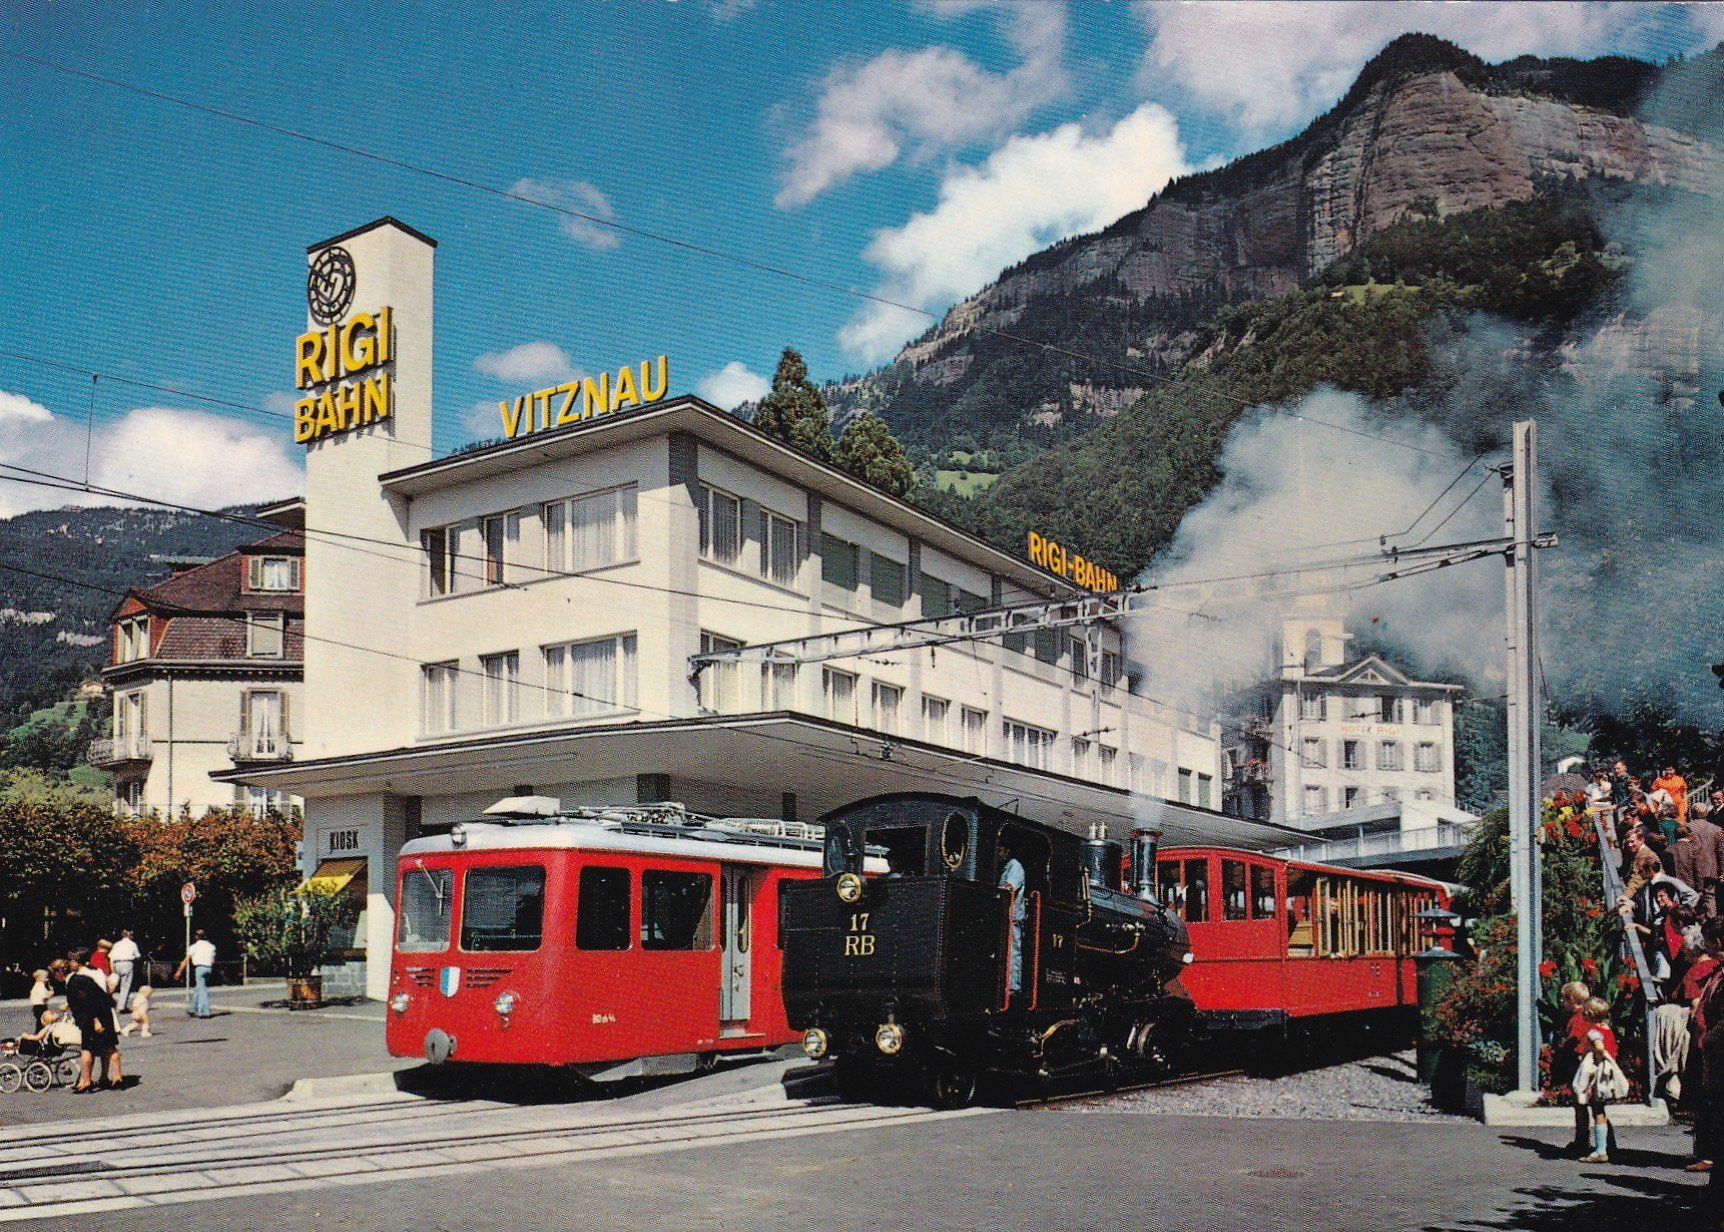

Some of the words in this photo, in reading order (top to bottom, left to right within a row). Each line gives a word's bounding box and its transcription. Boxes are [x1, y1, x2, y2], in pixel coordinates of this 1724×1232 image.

[296, 306, 392, 388] RIGI
[295, 373, 391, 443] BAHN
[499, 355, 668, 439] VITZNAU
[1028, 530, 1118, 593] RIGI-BAHN
[330, 829, 358, 850] KIOSK
[850, 912, 870, 931] 17
[1052, 933, 1064, 948] 17
[844, 934, 876, 956] RB
